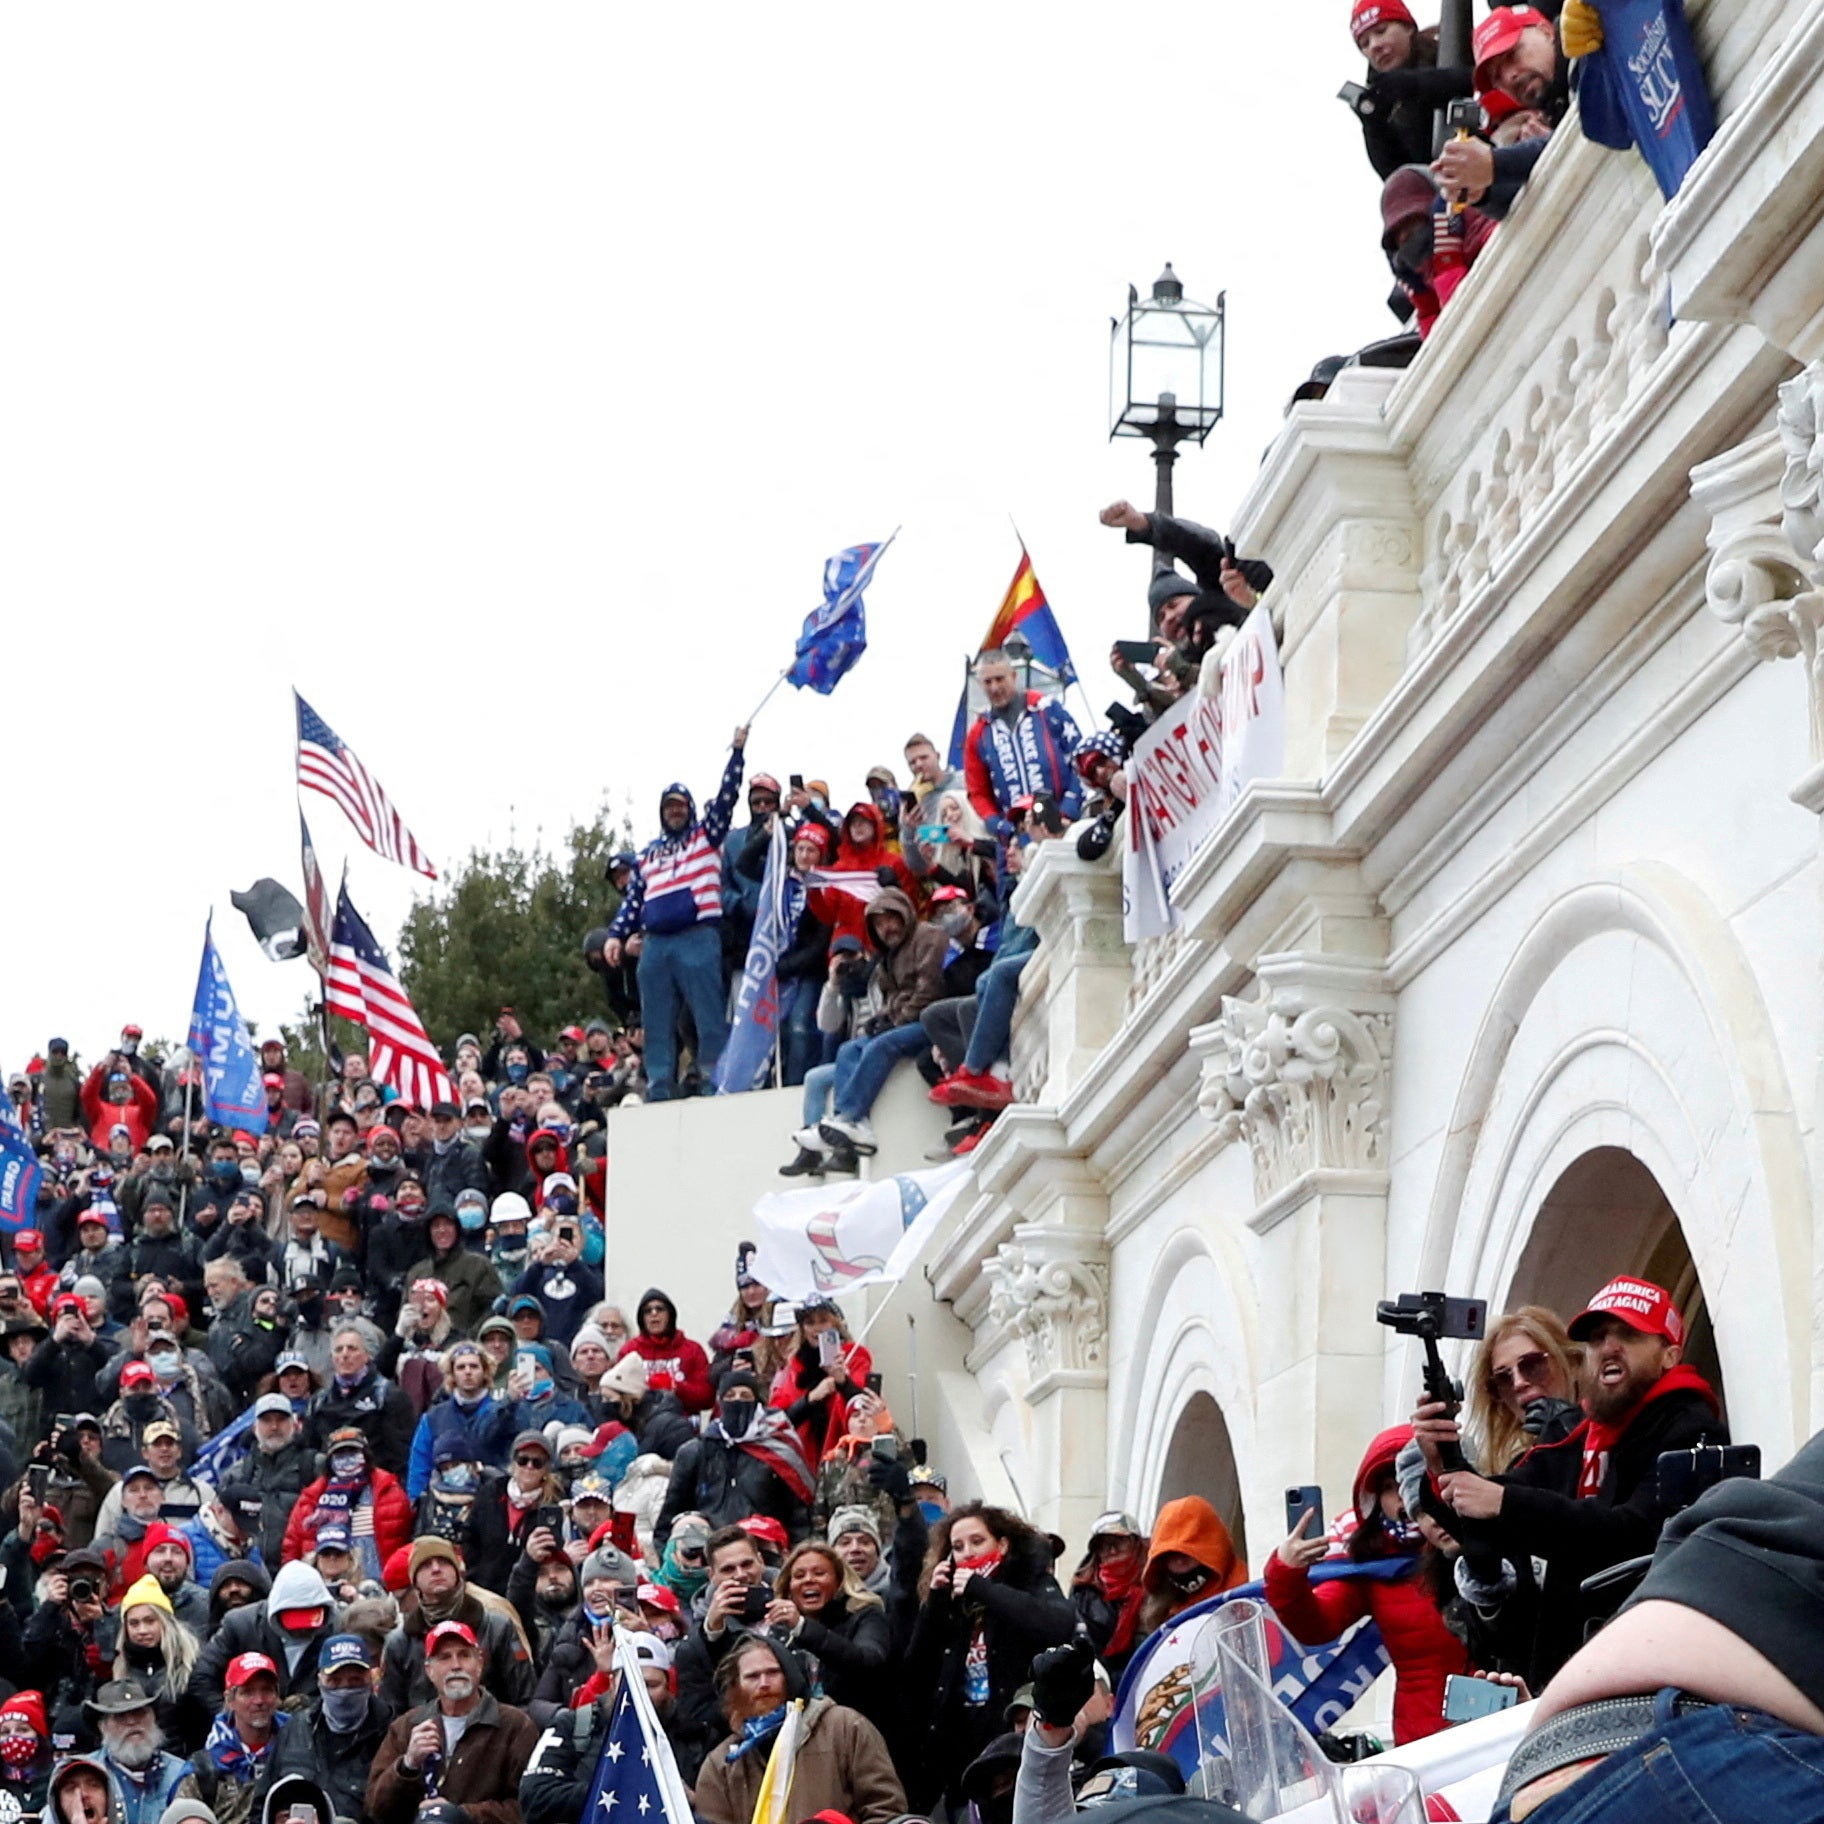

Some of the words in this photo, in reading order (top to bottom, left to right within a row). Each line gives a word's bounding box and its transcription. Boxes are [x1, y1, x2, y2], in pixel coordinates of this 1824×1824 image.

[1639, 44, 1680, 122] SUC
[994, 732, 1019, 782] GREAT
[1609, 1281, 1661, 1304] AMERICA
[1615, 1296, 1653, 1315] AGAIN
